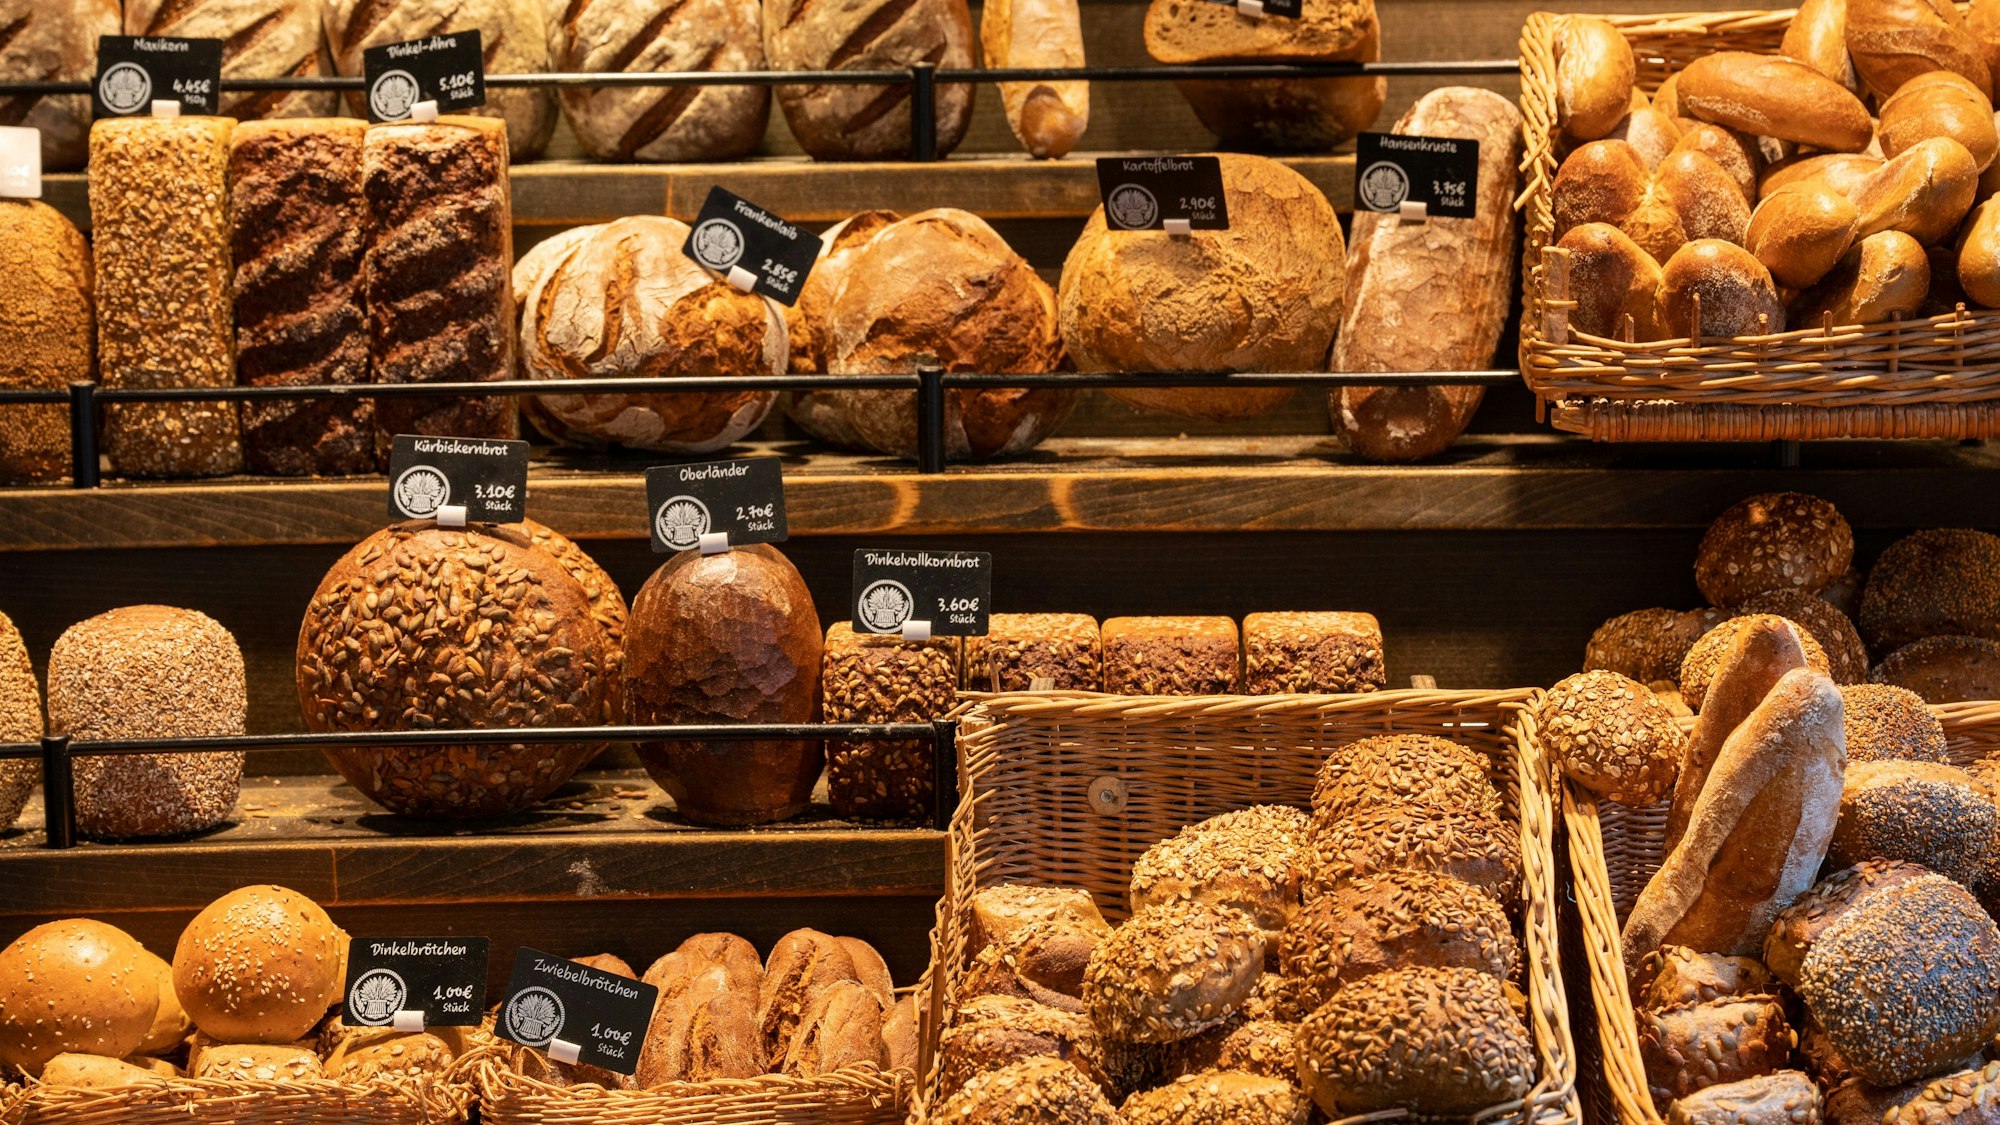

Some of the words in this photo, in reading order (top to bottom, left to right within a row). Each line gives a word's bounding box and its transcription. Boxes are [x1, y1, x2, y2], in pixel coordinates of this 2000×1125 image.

[133, 38, 189, 52] Maxikorn
[386, 36, 456, 59] Dinkel-Ähre
[172, 78, 211, 94] 4.45€
[439, 70, 475, 91] 5.10€
[449, 87, 474, 100] Stück
[1380, 136, 1457, 153] Hansenkruste
[1123, 158, 1194, 174] Kartoffelbrot
[1432, 180, 1466, 195] 3.75€
[1180, 197, 1216, 210] 2.90€
[1440, 197, 1465, 207] Stück
[734, 200, 798, 240] Frankenlaib
[1191, 210, 1216, 220] Stück
[761, 258, 798, 283] 2.85€
[765, 275, 790, 293] Stück
[414, 439, 509, 456] Kürbiskernbrot
[680, 463, 749, 481] Oberländer
[474, 484, 515, 499] 3.10€
[485, 500, 512, 511] Stück
[736, 503, 774, 520] 2.70€
[748, 520, 774, 532] Stück
[864, 552, 980, 568] Dinkelvollkornbrot
[937, 597, 979, 612] 3.60€
[949, 613, 976, 624] Stück
[370, 941, 467, 956] Dinkelbrötchen
[533, 958, 639, 999] Zwiebelbrötchen
[433, 984, 473, 1000] 1.00€
[442, 1001, 470, 1013] Stück
[590, 1023, 632, 1046] 1.00€
[597, 1042, 625, 1059] Stück
